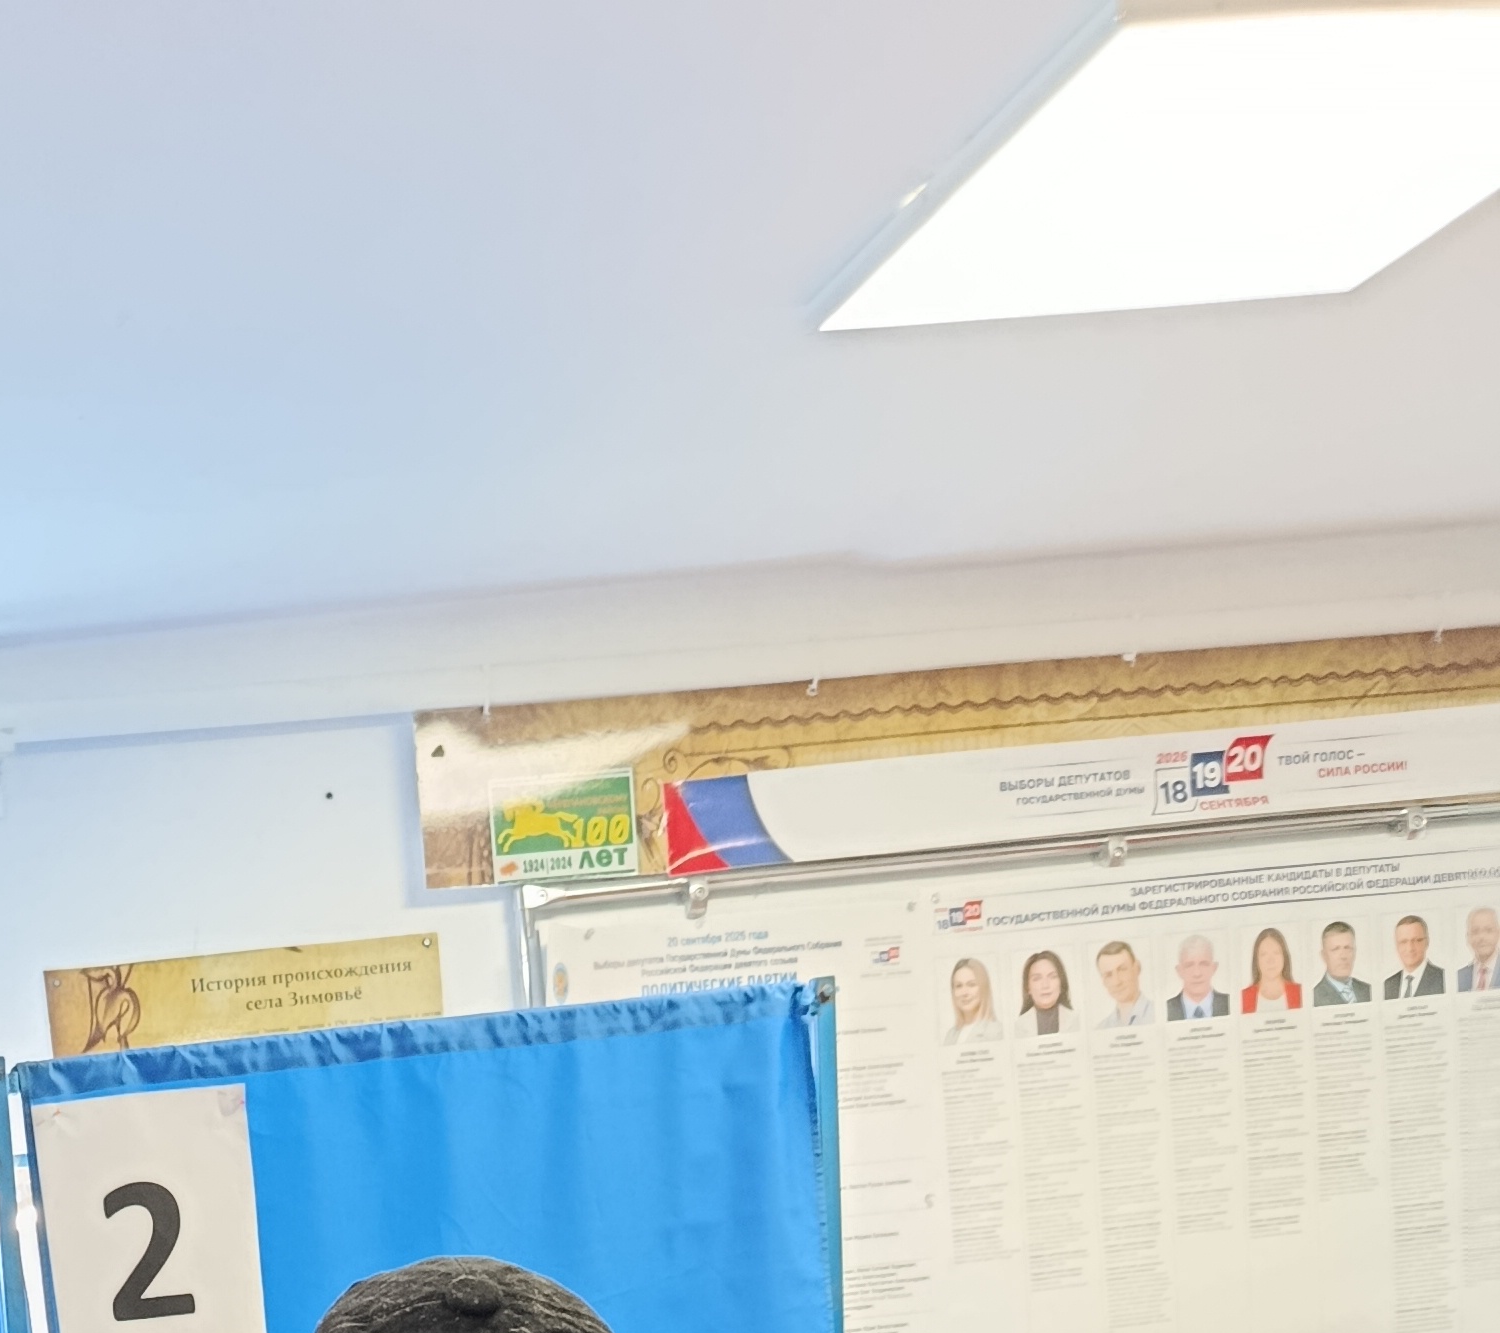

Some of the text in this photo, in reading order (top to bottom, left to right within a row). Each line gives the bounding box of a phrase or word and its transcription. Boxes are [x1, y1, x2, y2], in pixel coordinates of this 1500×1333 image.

[1278, 751, 1310, 766] ТВОЙ
[1313, 749, 1354, 763] ГОЛОС
[1318, 760, 1407, 778] СИЛА РОССИИ!
[1000, 769, 1130, 792] ВЫБОРЫ ДЕПУТАТОВ
[1159, 744, 1262, 805] 18 19 20
[1016, 785, 1145, 806] ГОСУДАРСТВЕННОЙ ДУМЫ
[1200, 795, 1269, 811] СЕНТЯБРЯ
[571, 814, 630, 848] 100
[1130, 862, 1400, 897] ЗАРЕГИСТРИРОВАННЫЕ КАНДИДАТЫ В ДЕПУТАТЫ
[987, 904, 1099, 927] ГОСУДАРСТВЕННОЙ
[1101, 902, 1135, 916] ДУМЫ
[1138, 892, 1229, 911] ФЕДЕРАЛЬНОГО
[1231, 886, 1290, 901] СОБРАНИЯ
[1292, 878, 1364, 896] РОССИЙСКОЙ
[1366, 874, 1431, 890] ФЕДЕРАЦИИ
[191, 960, 412, 995] История происхождения
[245, 985, 363, 1012] села Зимовьё
[102, 1180, 196, 1323] 2
